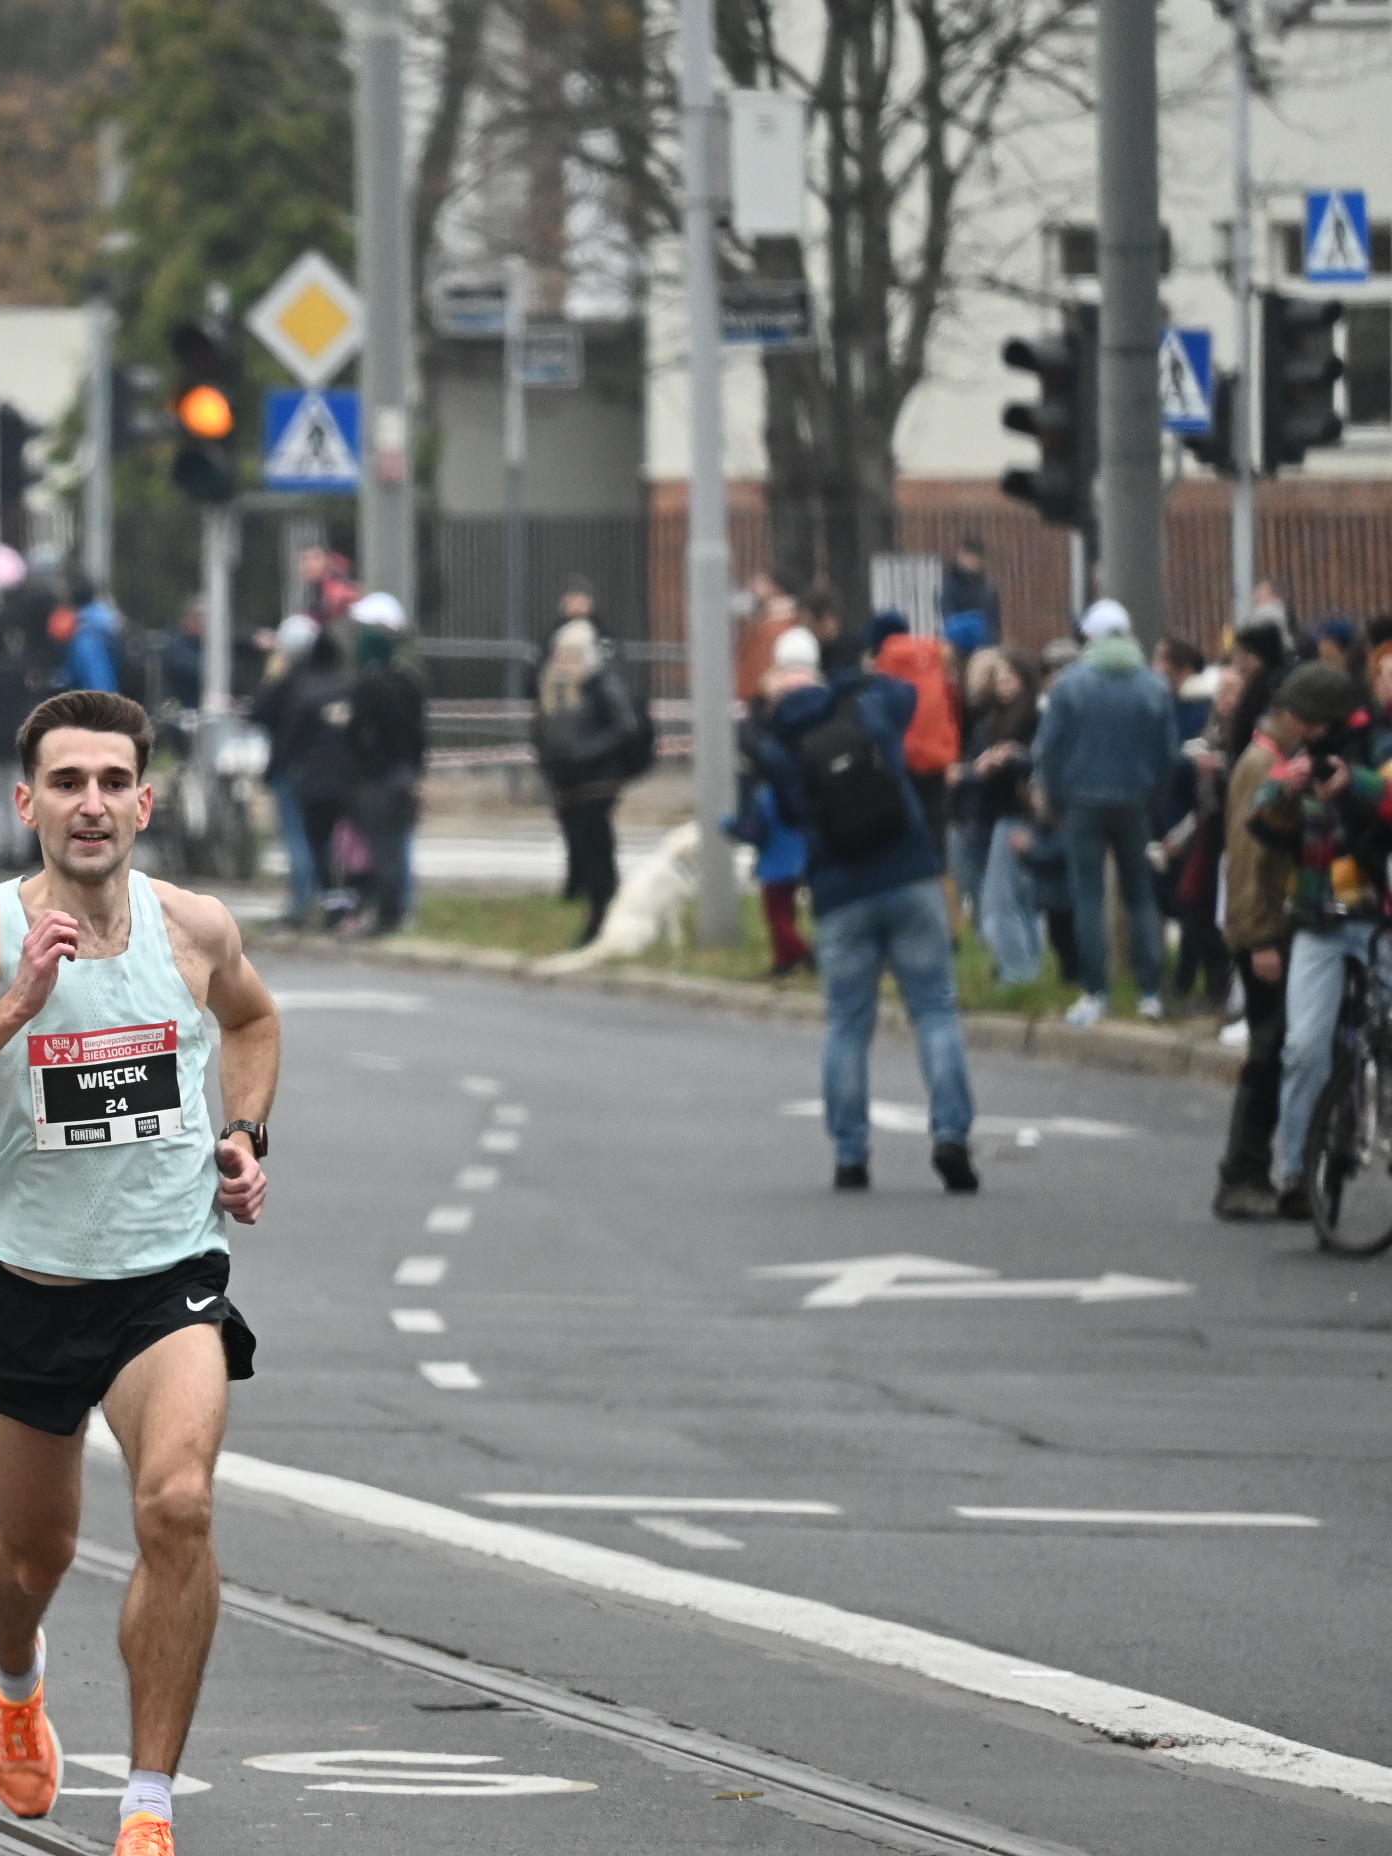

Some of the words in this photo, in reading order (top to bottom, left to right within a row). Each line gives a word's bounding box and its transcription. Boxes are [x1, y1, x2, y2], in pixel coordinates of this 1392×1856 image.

[52, 1038, 70, 1047] RUN
[83, 1049, 106, 1061] BIEG
[107, 1042, 164, 1058] 1000-LECIA
[77, 1065, 148, 1090] WIĘCEK
[105, 1097, 129, 1114] 24
[70, 1127, 106, 1142] FORTUNA
